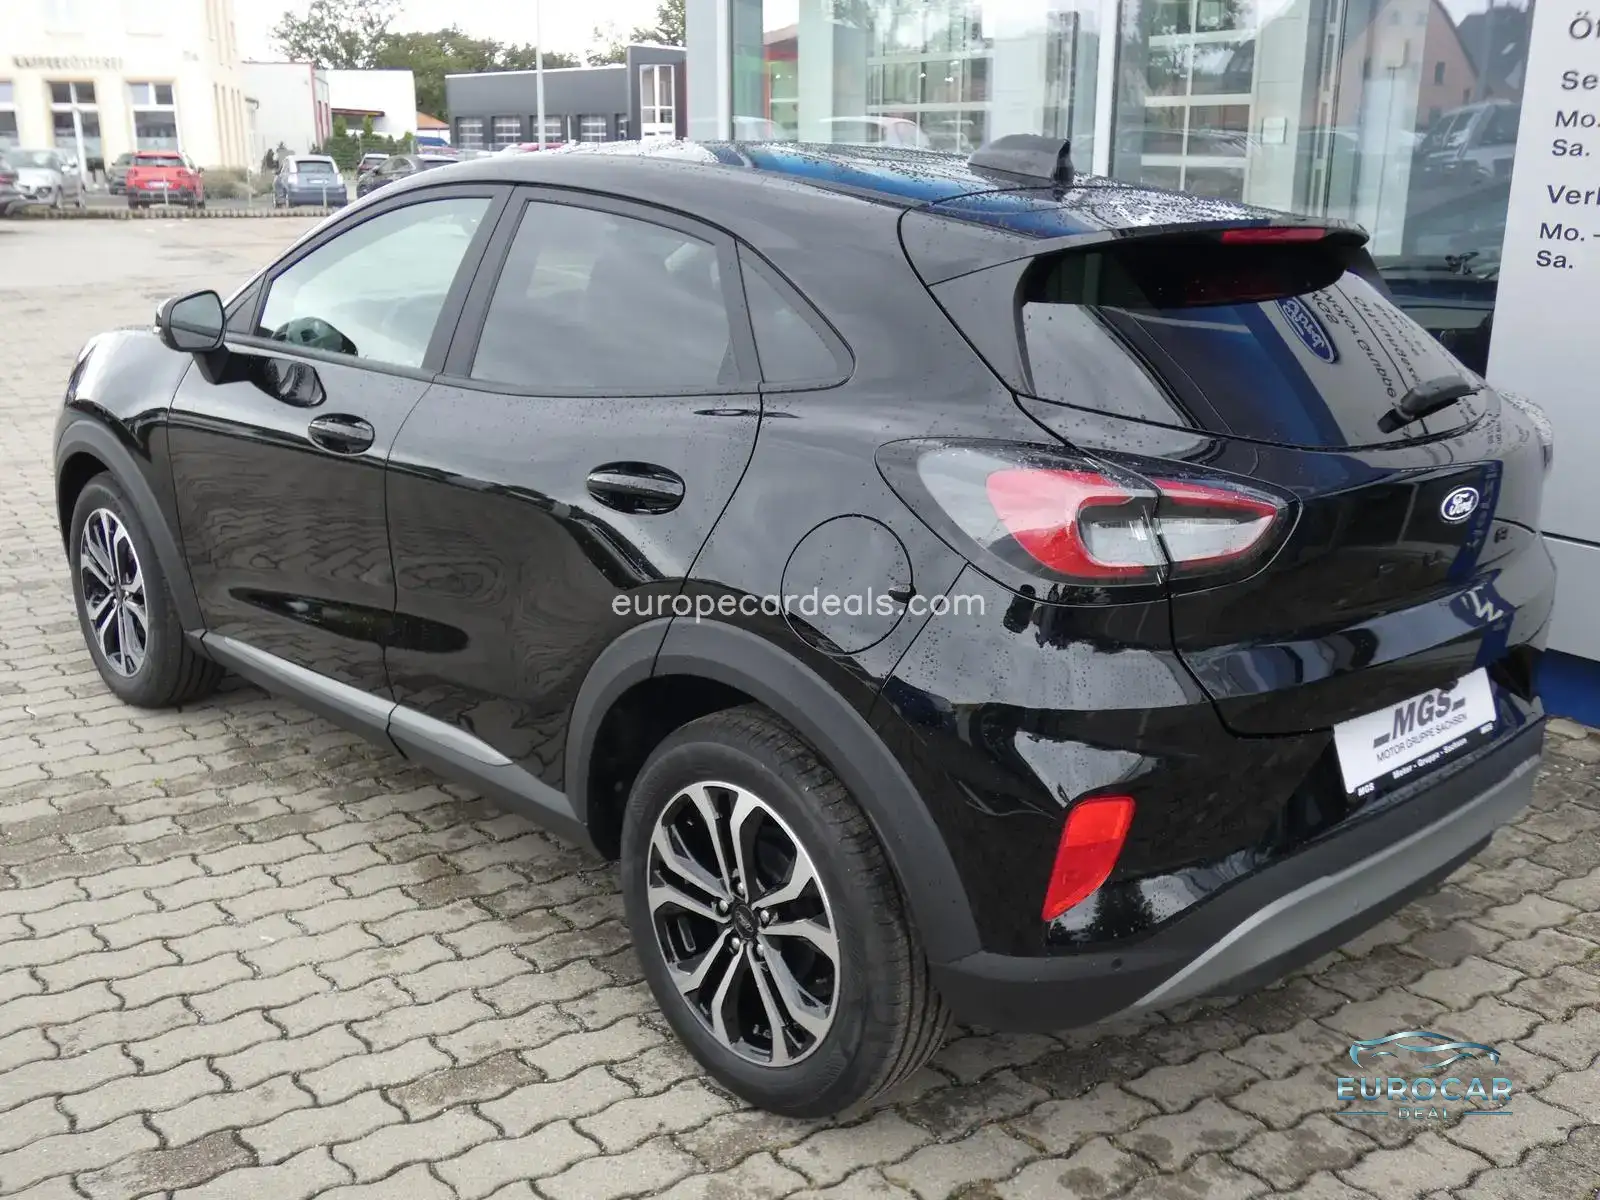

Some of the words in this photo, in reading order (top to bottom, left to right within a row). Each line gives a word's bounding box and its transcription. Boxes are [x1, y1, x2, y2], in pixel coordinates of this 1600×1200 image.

[1552, 139, 1590, 157] Sa.
[1539, 222, 1585, 242] Mo.
[1536, 249, 1574, 269] Sa.
[1392, 689, 1451, 741] MGS
[1357, 782, 1375, 796] MGS
